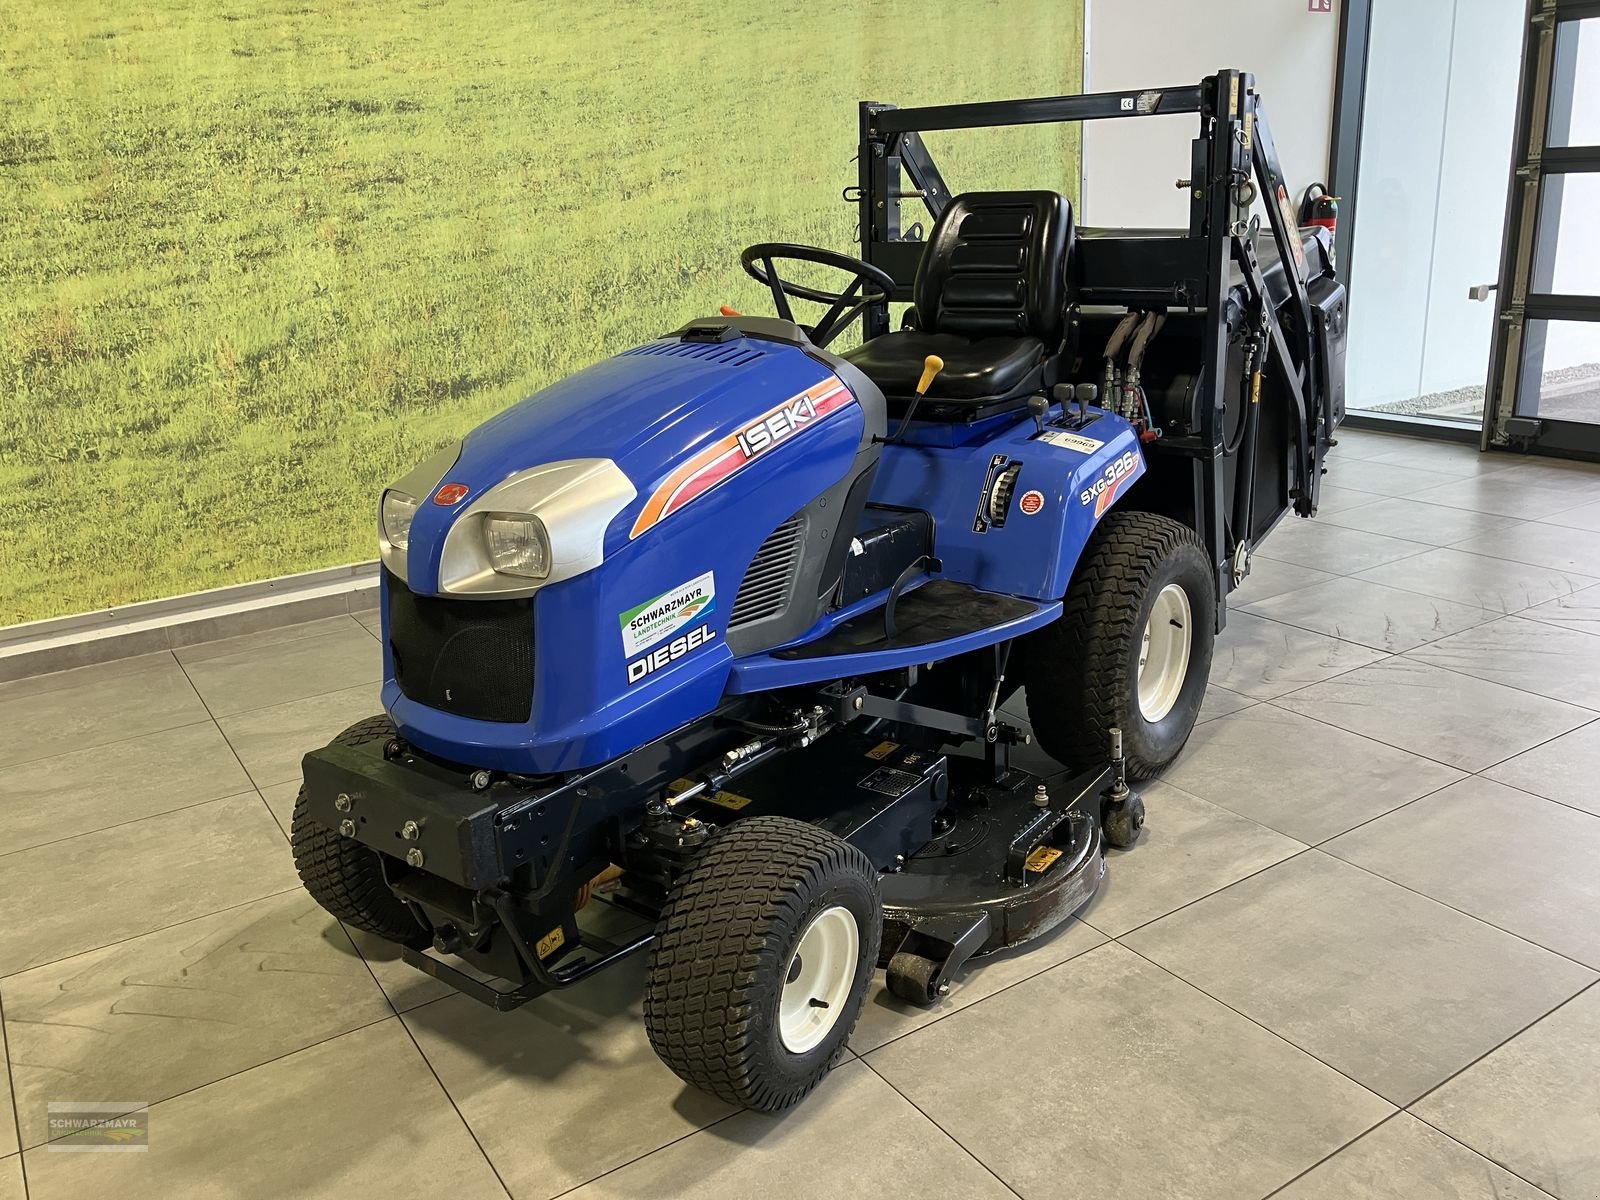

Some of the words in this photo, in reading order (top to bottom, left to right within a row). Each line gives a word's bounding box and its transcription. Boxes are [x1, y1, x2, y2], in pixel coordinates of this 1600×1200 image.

[736, 394, 817, 459] ISEKI
[630, 588, 702, 630] SCHWARZMAYR
[633, 612, 676, 638] LANDTECHNIK
[627, 623, 716, 684] DIESEL
